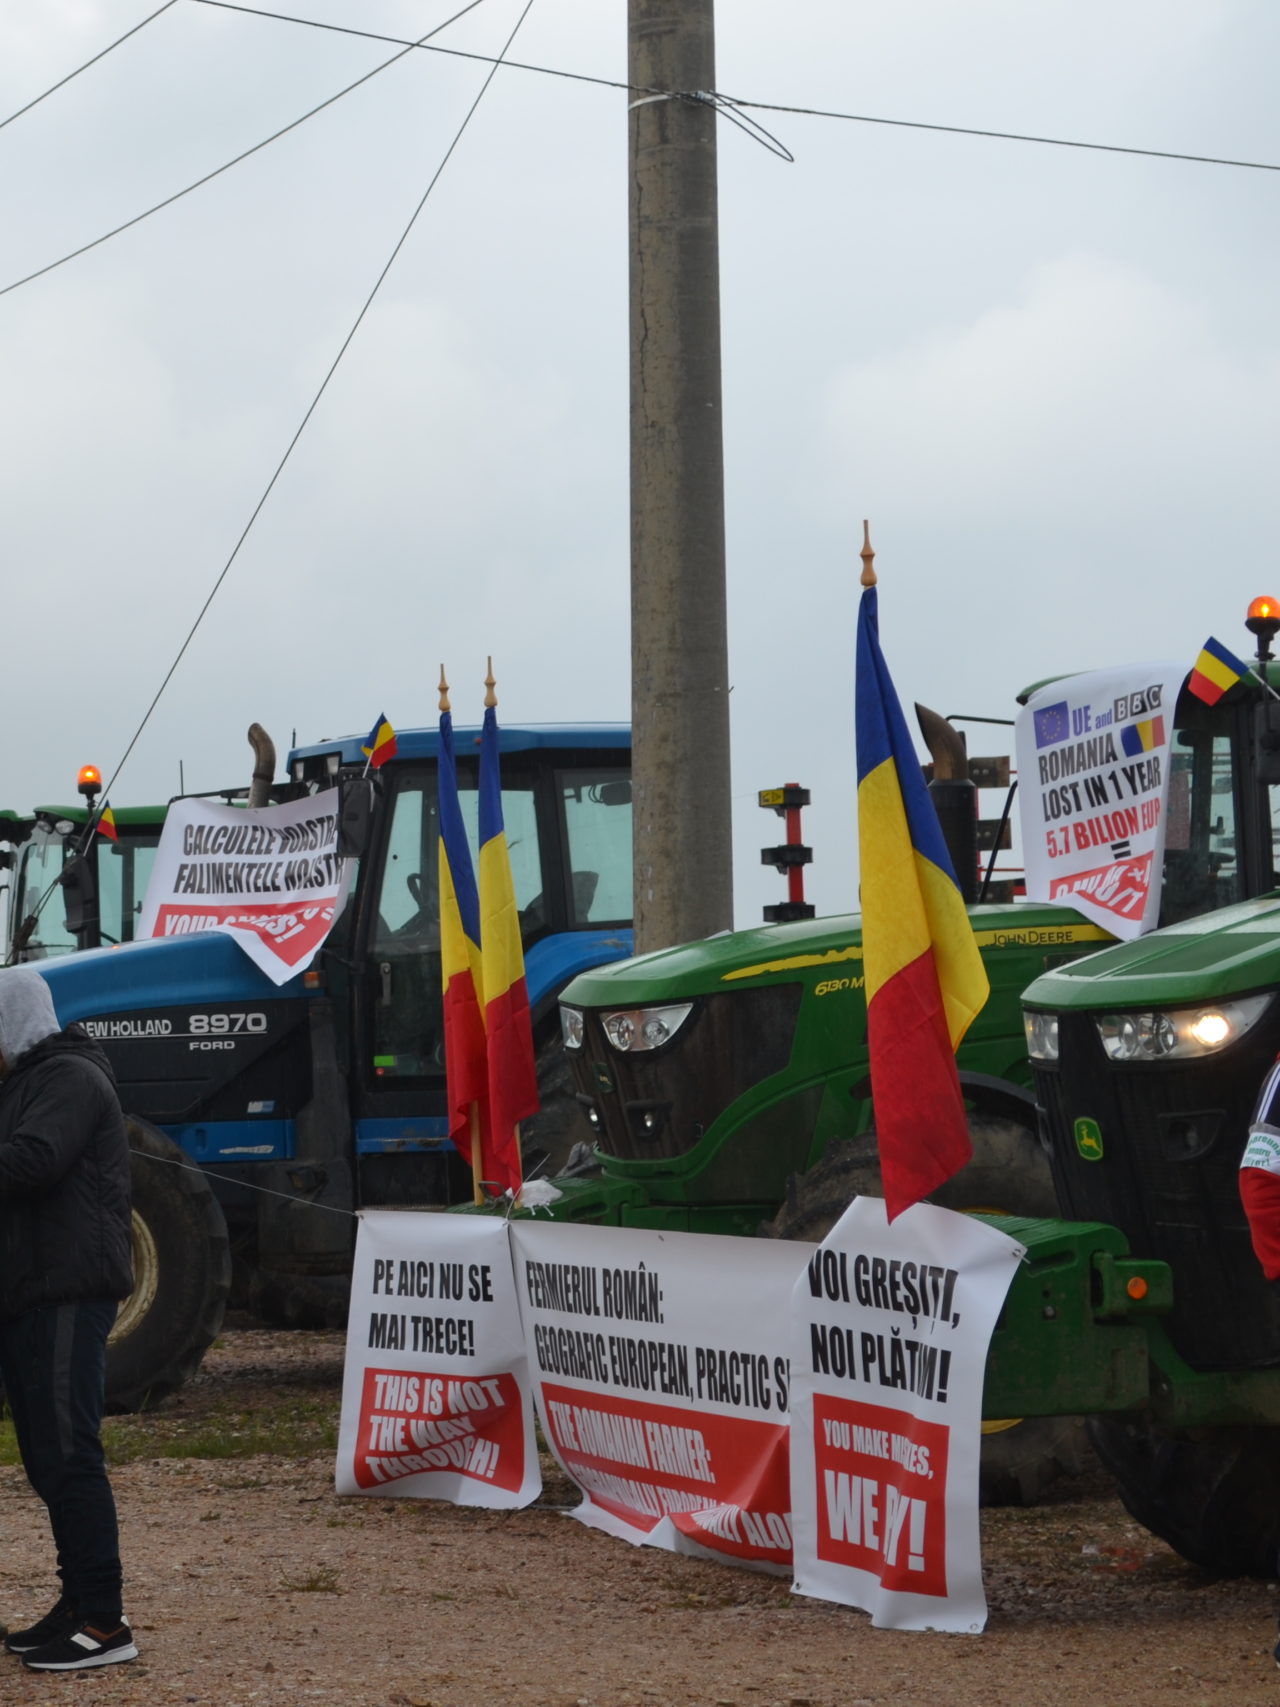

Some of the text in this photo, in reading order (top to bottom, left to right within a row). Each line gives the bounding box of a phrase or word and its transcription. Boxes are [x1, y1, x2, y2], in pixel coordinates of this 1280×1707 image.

[1072, 684, 1163, 736] UE and BBC
[1038, 732, 1118, 786] ROMANIA
[1042, 755, 1162, 823] LOST IN 1 YEAR
[183, 824, 278, 856] CALCULELE
[1045, 823, 1071, 859] 5.7
[1073, 807, 1139, 851] BILION
[173, 861, 282, 894] FALIMENTELE
[993, 931, 1073, 947] JOHN DEERE
[80, 1019, 172, 1037] EW HOLLAND
[189, 1013, 267, 1033] 8970
[189, 1041, 235, 1050] FORD
[373, 1259, 494, 1302] PE AICI NU SE
[526, 1260, 664, 1324] FERMIERUL ROMÂN:
[808, 1249, 851, 1303] VOI
[368, 1313, 475, 1356] MAI TRECE!
[810, 1323, 856, 1380] NOI
[534, 1323, 609, 1384] GEOGRAFIC
[608, 1336, 694, 1403] EUROPEAN,
[695, 1347, 771, 1411] PRACTIC
[374, 1374, 505, 1415] THIS IS NOT
[369, 1415, 476, 1451] THE WAY
[549, 1400, 716, 1484] THE ROMANIAN FARMER:
[823, 1418, 850, 1450] YOU
[852, 1424, 889, 1459] MAKE
[824, 1469, 879, 1551] WE
